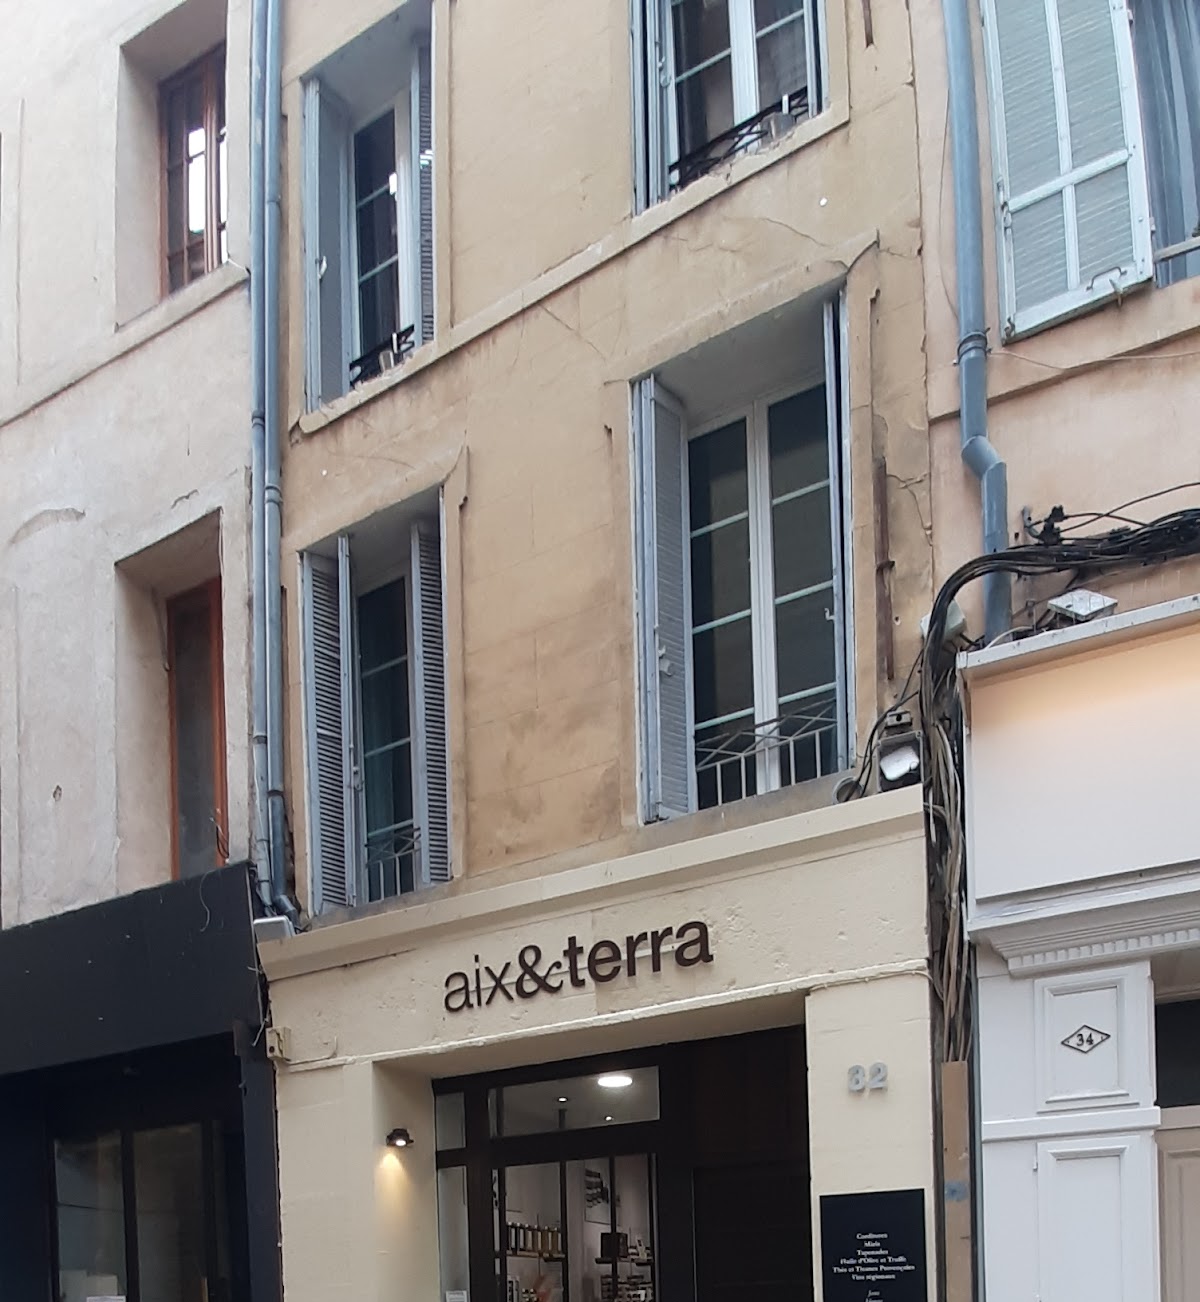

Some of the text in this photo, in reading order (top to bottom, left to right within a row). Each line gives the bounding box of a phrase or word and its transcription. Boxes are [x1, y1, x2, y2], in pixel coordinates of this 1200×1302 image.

[444, 920, 714, 1012] aix&terra
[1076, 1032, 1094, 1047] 34
[847, 1062, 888, 1092] 32
